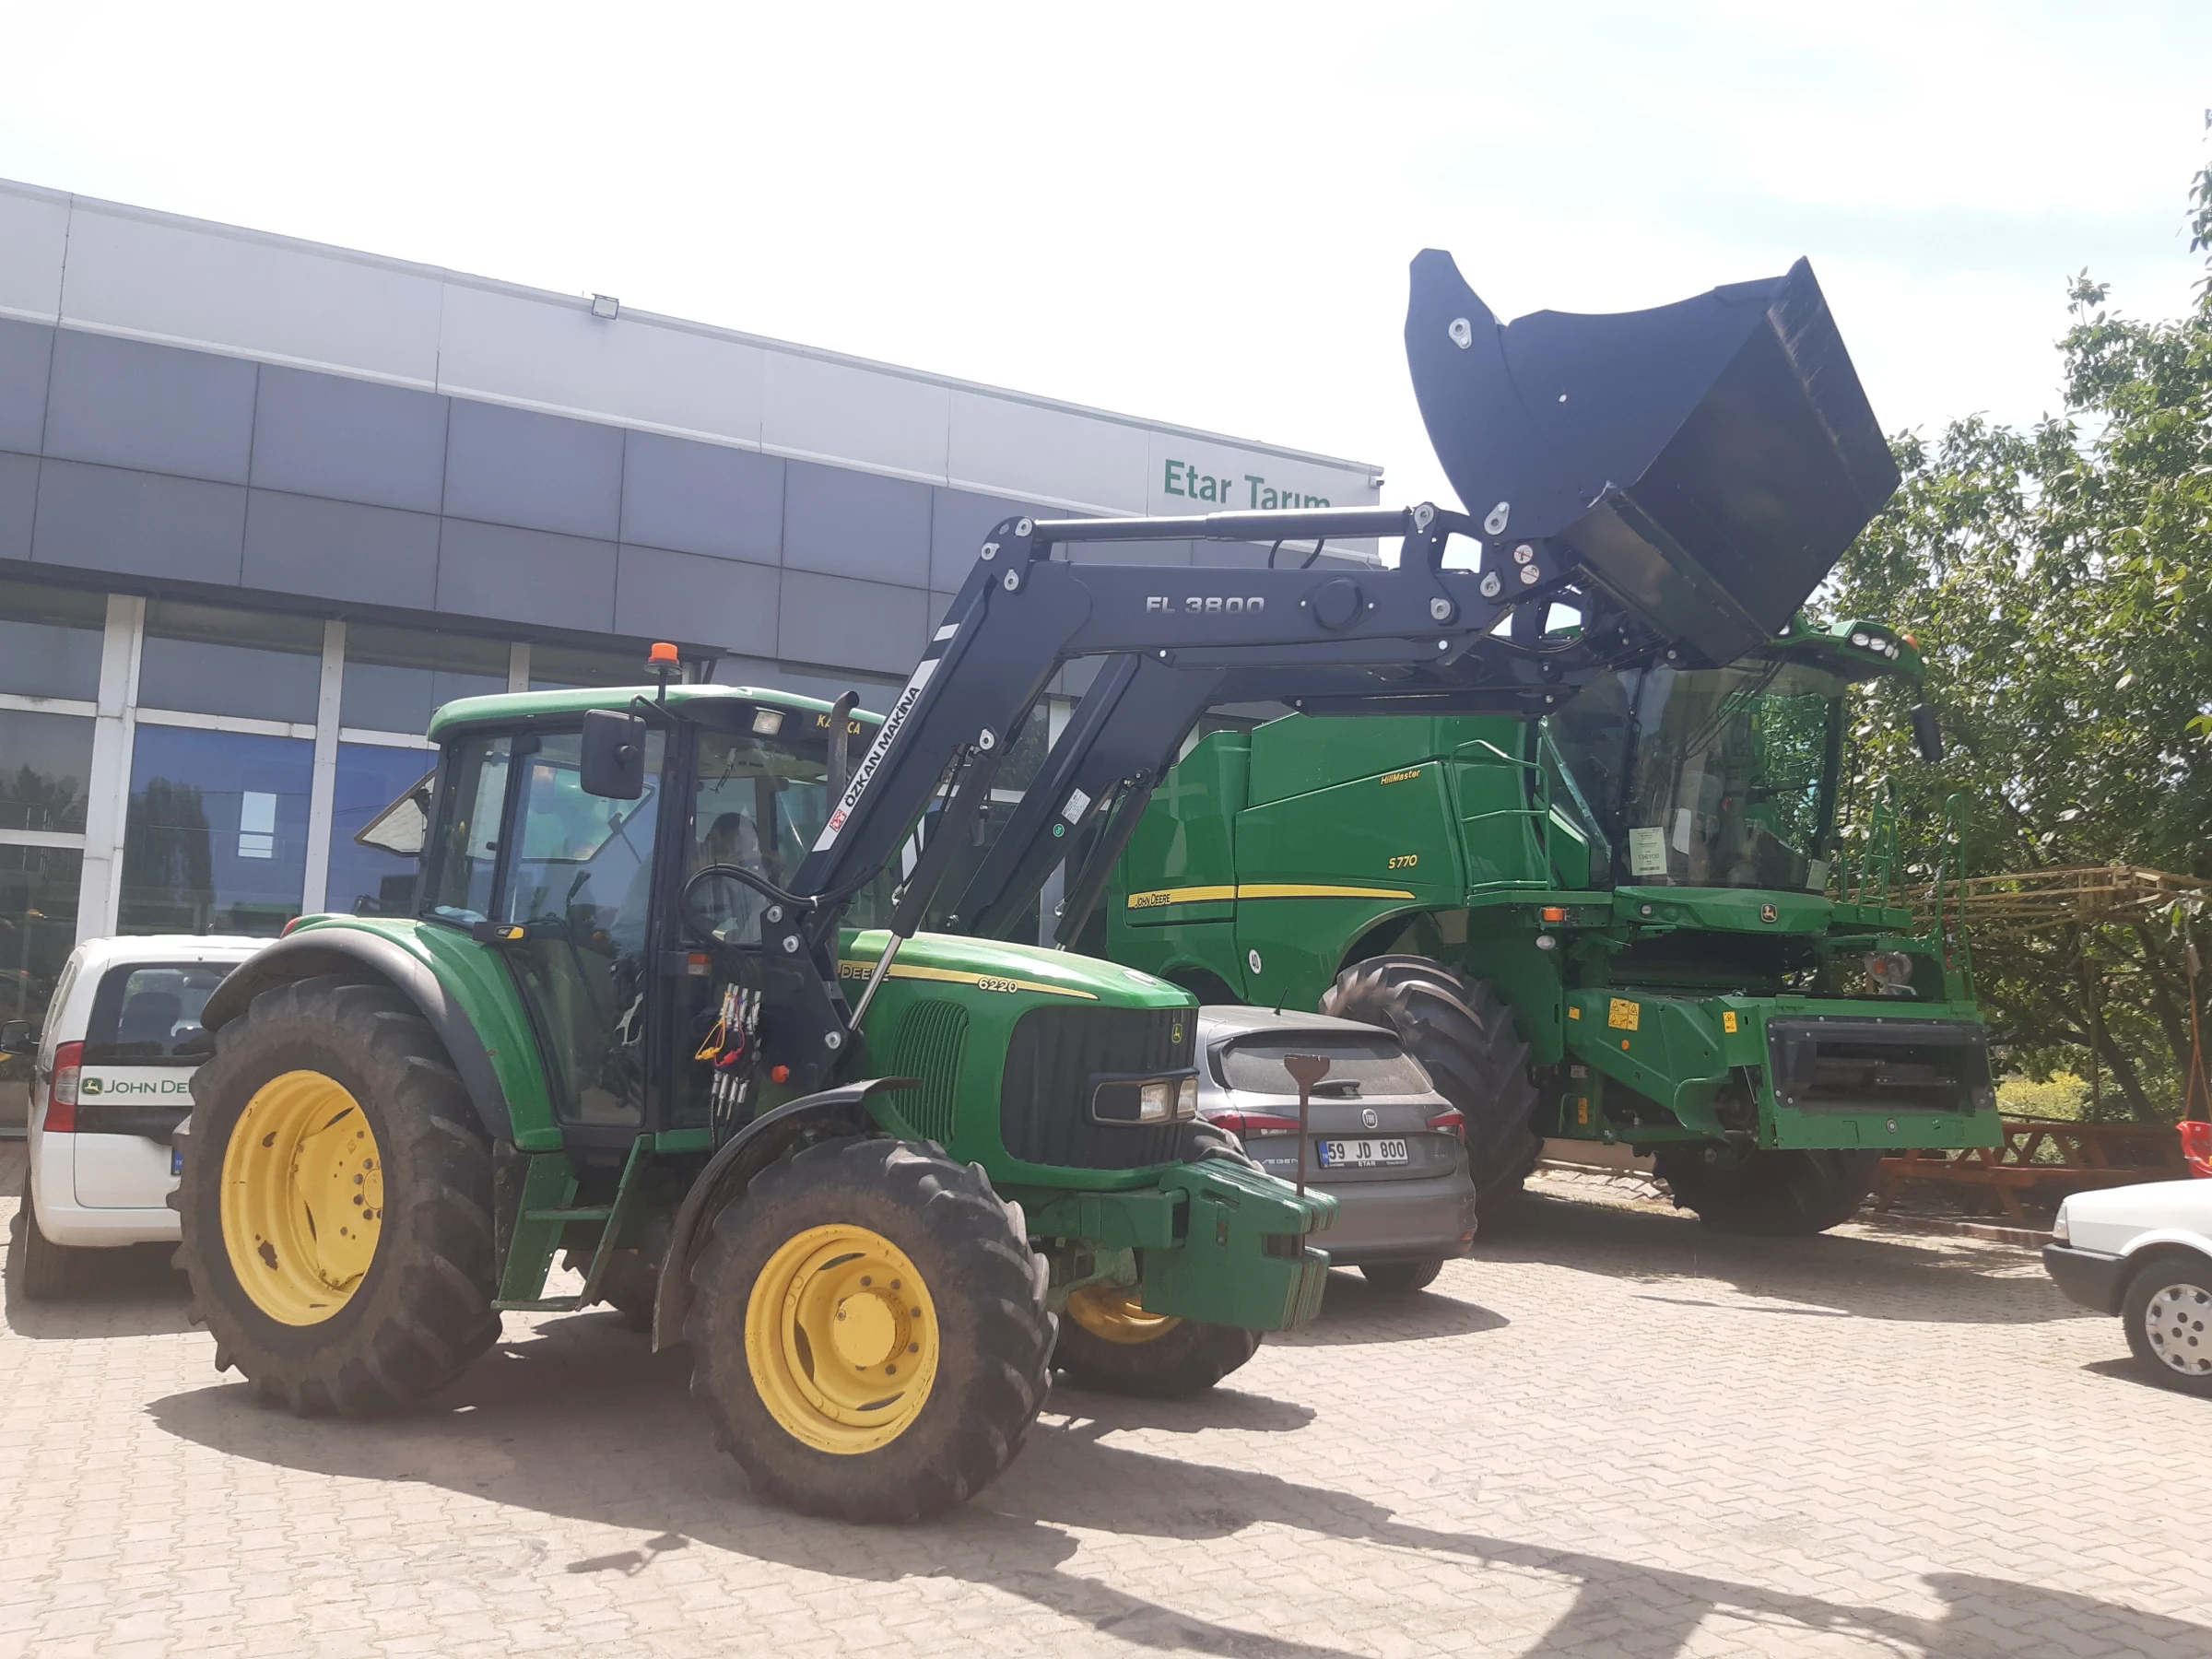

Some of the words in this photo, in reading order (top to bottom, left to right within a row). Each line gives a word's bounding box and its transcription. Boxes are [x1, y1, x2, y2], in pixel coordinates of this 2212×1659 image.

[1164, 459, 1232, 504] Etar
[1146, 596, 1176, 615] FL
[1184, 596, 1265, 615] 3800
[844, 750, 882, 807] ÖZKAN
[877, 687, 921, 751] MAKİNA
[1380, 770, 1421, 785] HillMaster
[1388, 854, 1418, 869] S770
[1134, 895, 1150, 908] JOHN
[1150, 893, 1171, 906] DEERE
[978, 977, 1018, 993] 6220
[104, 1079, 158, 1094] JOHN
[160, 1080, 190, 1094] DE
[1328, 1143, 1346, 1159] 59
[1356, 1142, 1371, 1159] JD
[1380, 1141, 1406, 1158] 800
